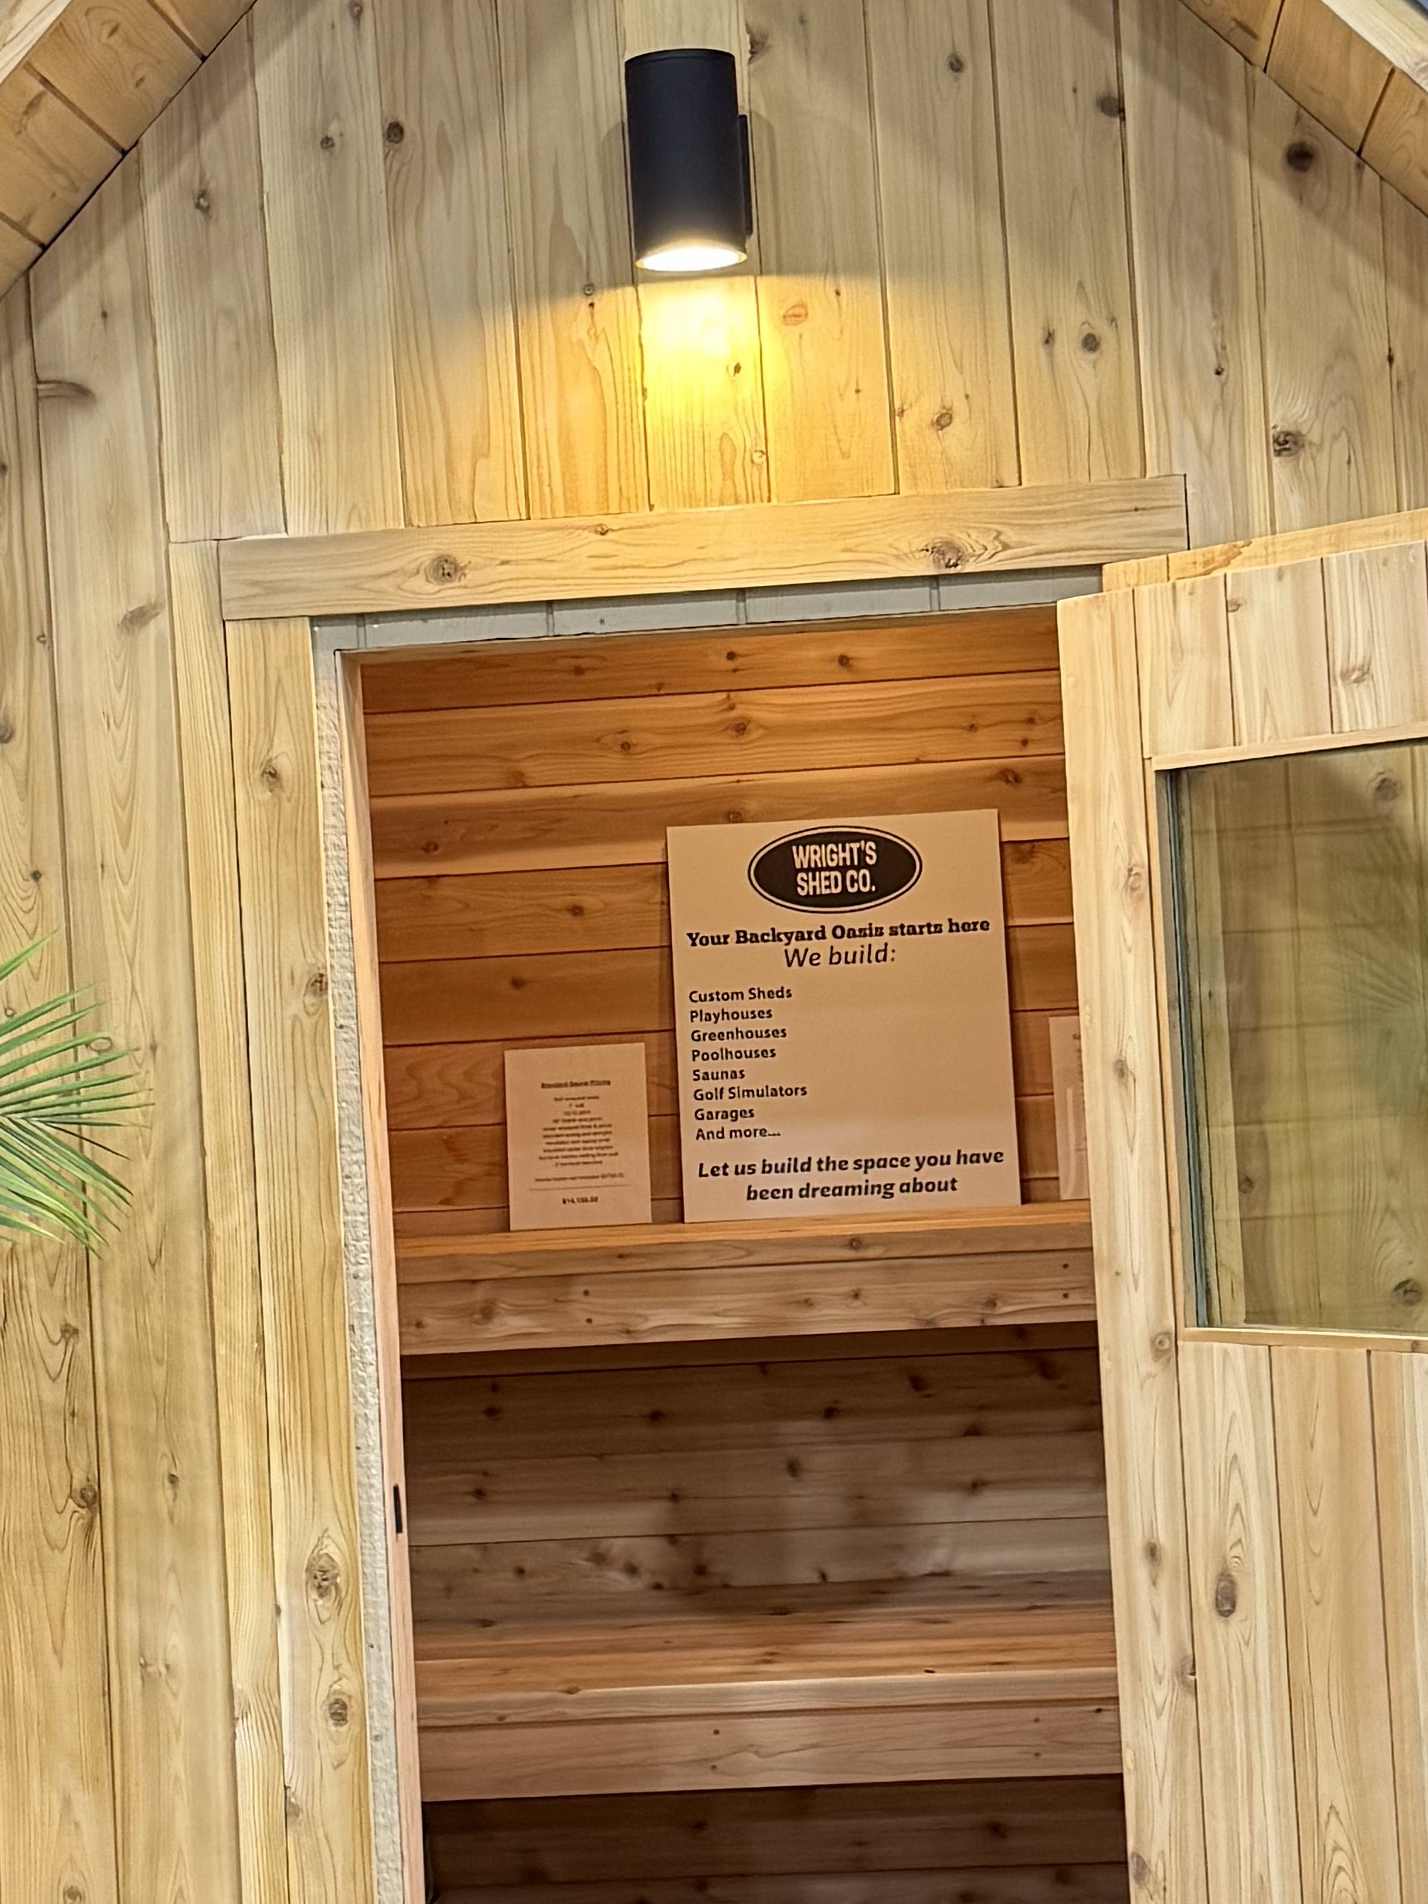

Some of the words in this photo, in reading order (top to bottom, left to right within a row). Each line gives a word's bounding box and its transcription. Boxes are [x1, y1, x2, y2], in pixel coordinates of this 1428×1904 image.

[791, 840, 878, 870] WRIGHT'S
[796, 869, 843, 896] SHED
[845, 868, 877, 893] CO.
[686, 932, 730, 947] Your
[735, 925, 827, 946] Backyard
[831, 923, 885, 940] Oasis
[888, 921, 943, 937] starts
[947, 918, 990, 934] here
[784, 947, 822, 968] We
[828, 942, 896, 966] build:
[688, 990, 745, 1003] Custom
[748, 986, 793, 1000] Sheds
[689, 1008, 773, 1024] Playhouses
[690, 1027, 787, 1042] Greenhouses
[691, 1047, 777, 1062] Poolhouses
[692, 1068, 746, 1081] Saunas
[693, 1086, 725, 1101] Golf
[728, 1084, 808, 1100] Simulators
[694, 1108, 755, 1122] Garages
[695, 1127, 725, 1141] And
[697, 1161, 730, 1178] Let
[734, 1162, 757, 1176] us
[761, 1156, 812, 1175] build
[816, 1154, 849, 1172] the
[852, 1154, 911, 1174] space
[914, 1153, 952, 1172] you
[955, 1149, 1004, 1165] have
[746, 1184, 794, 1201] been
[798, 1178, 896, 1200] dreaming
[899, 1176, 959, 1194] about
